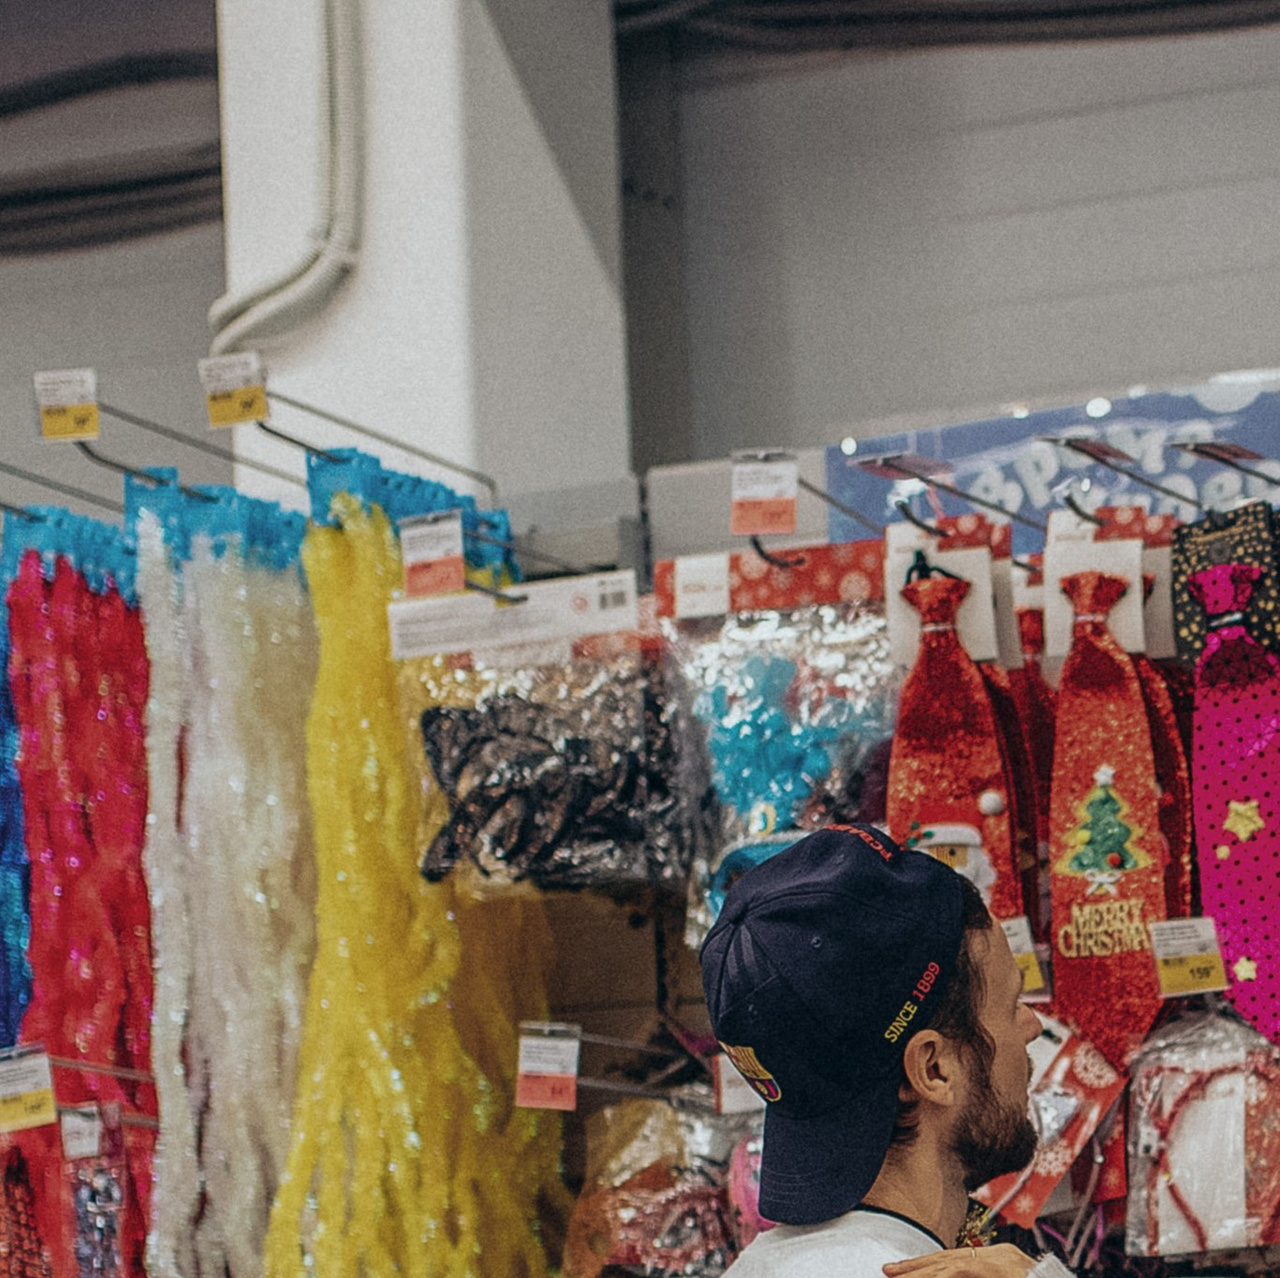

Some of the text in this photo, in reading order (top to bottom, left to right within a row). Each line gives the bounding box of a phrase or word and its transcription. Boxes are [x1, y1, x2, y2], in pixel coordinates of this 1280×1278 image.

[1071, 899, 1145, 930] MERRY
[1058, 921, 1156, 958] CHRISTMA
[884, 961, 941, 1043] SINCE 1899
